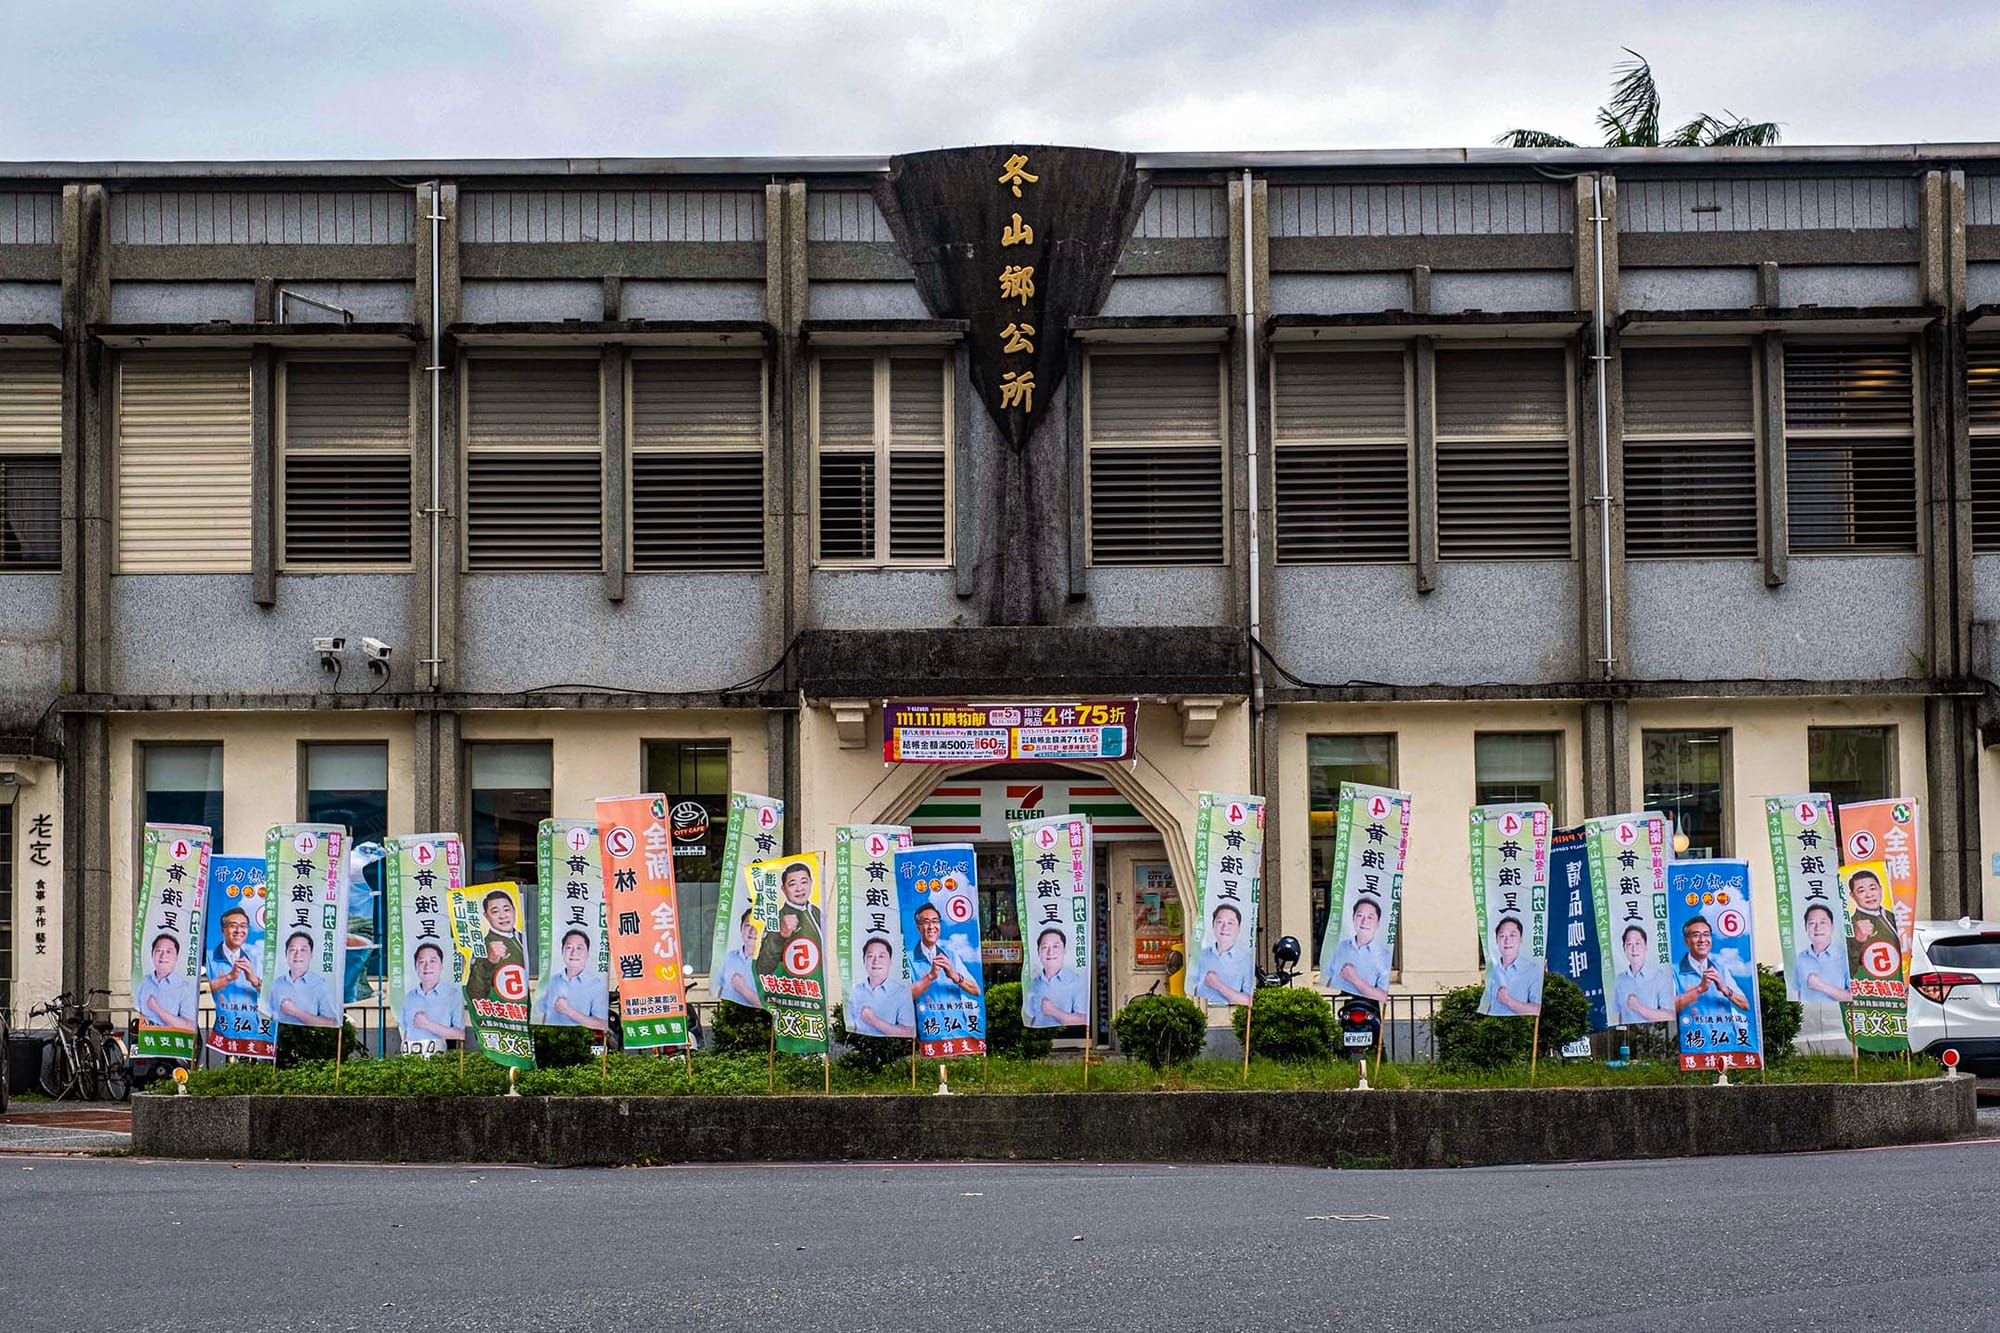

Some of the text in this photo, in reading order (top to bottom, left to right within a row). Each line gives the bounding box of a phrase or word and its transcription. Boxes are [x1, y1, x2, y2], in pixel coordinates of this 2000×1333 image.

[998, 153, 1039, 414] 冬山鄉公所
[1043, 705, 1126, 726] 4件75折
[35, 879, 46, 955] 食事 手作 藝文
[952, 900, 967, 918] 6
[1724, 914, 1738, 932] 6
[923, 1016, 983, 1035] 楊弘旻
[1686, 1029, 1753, 1048] 楊弘旻
